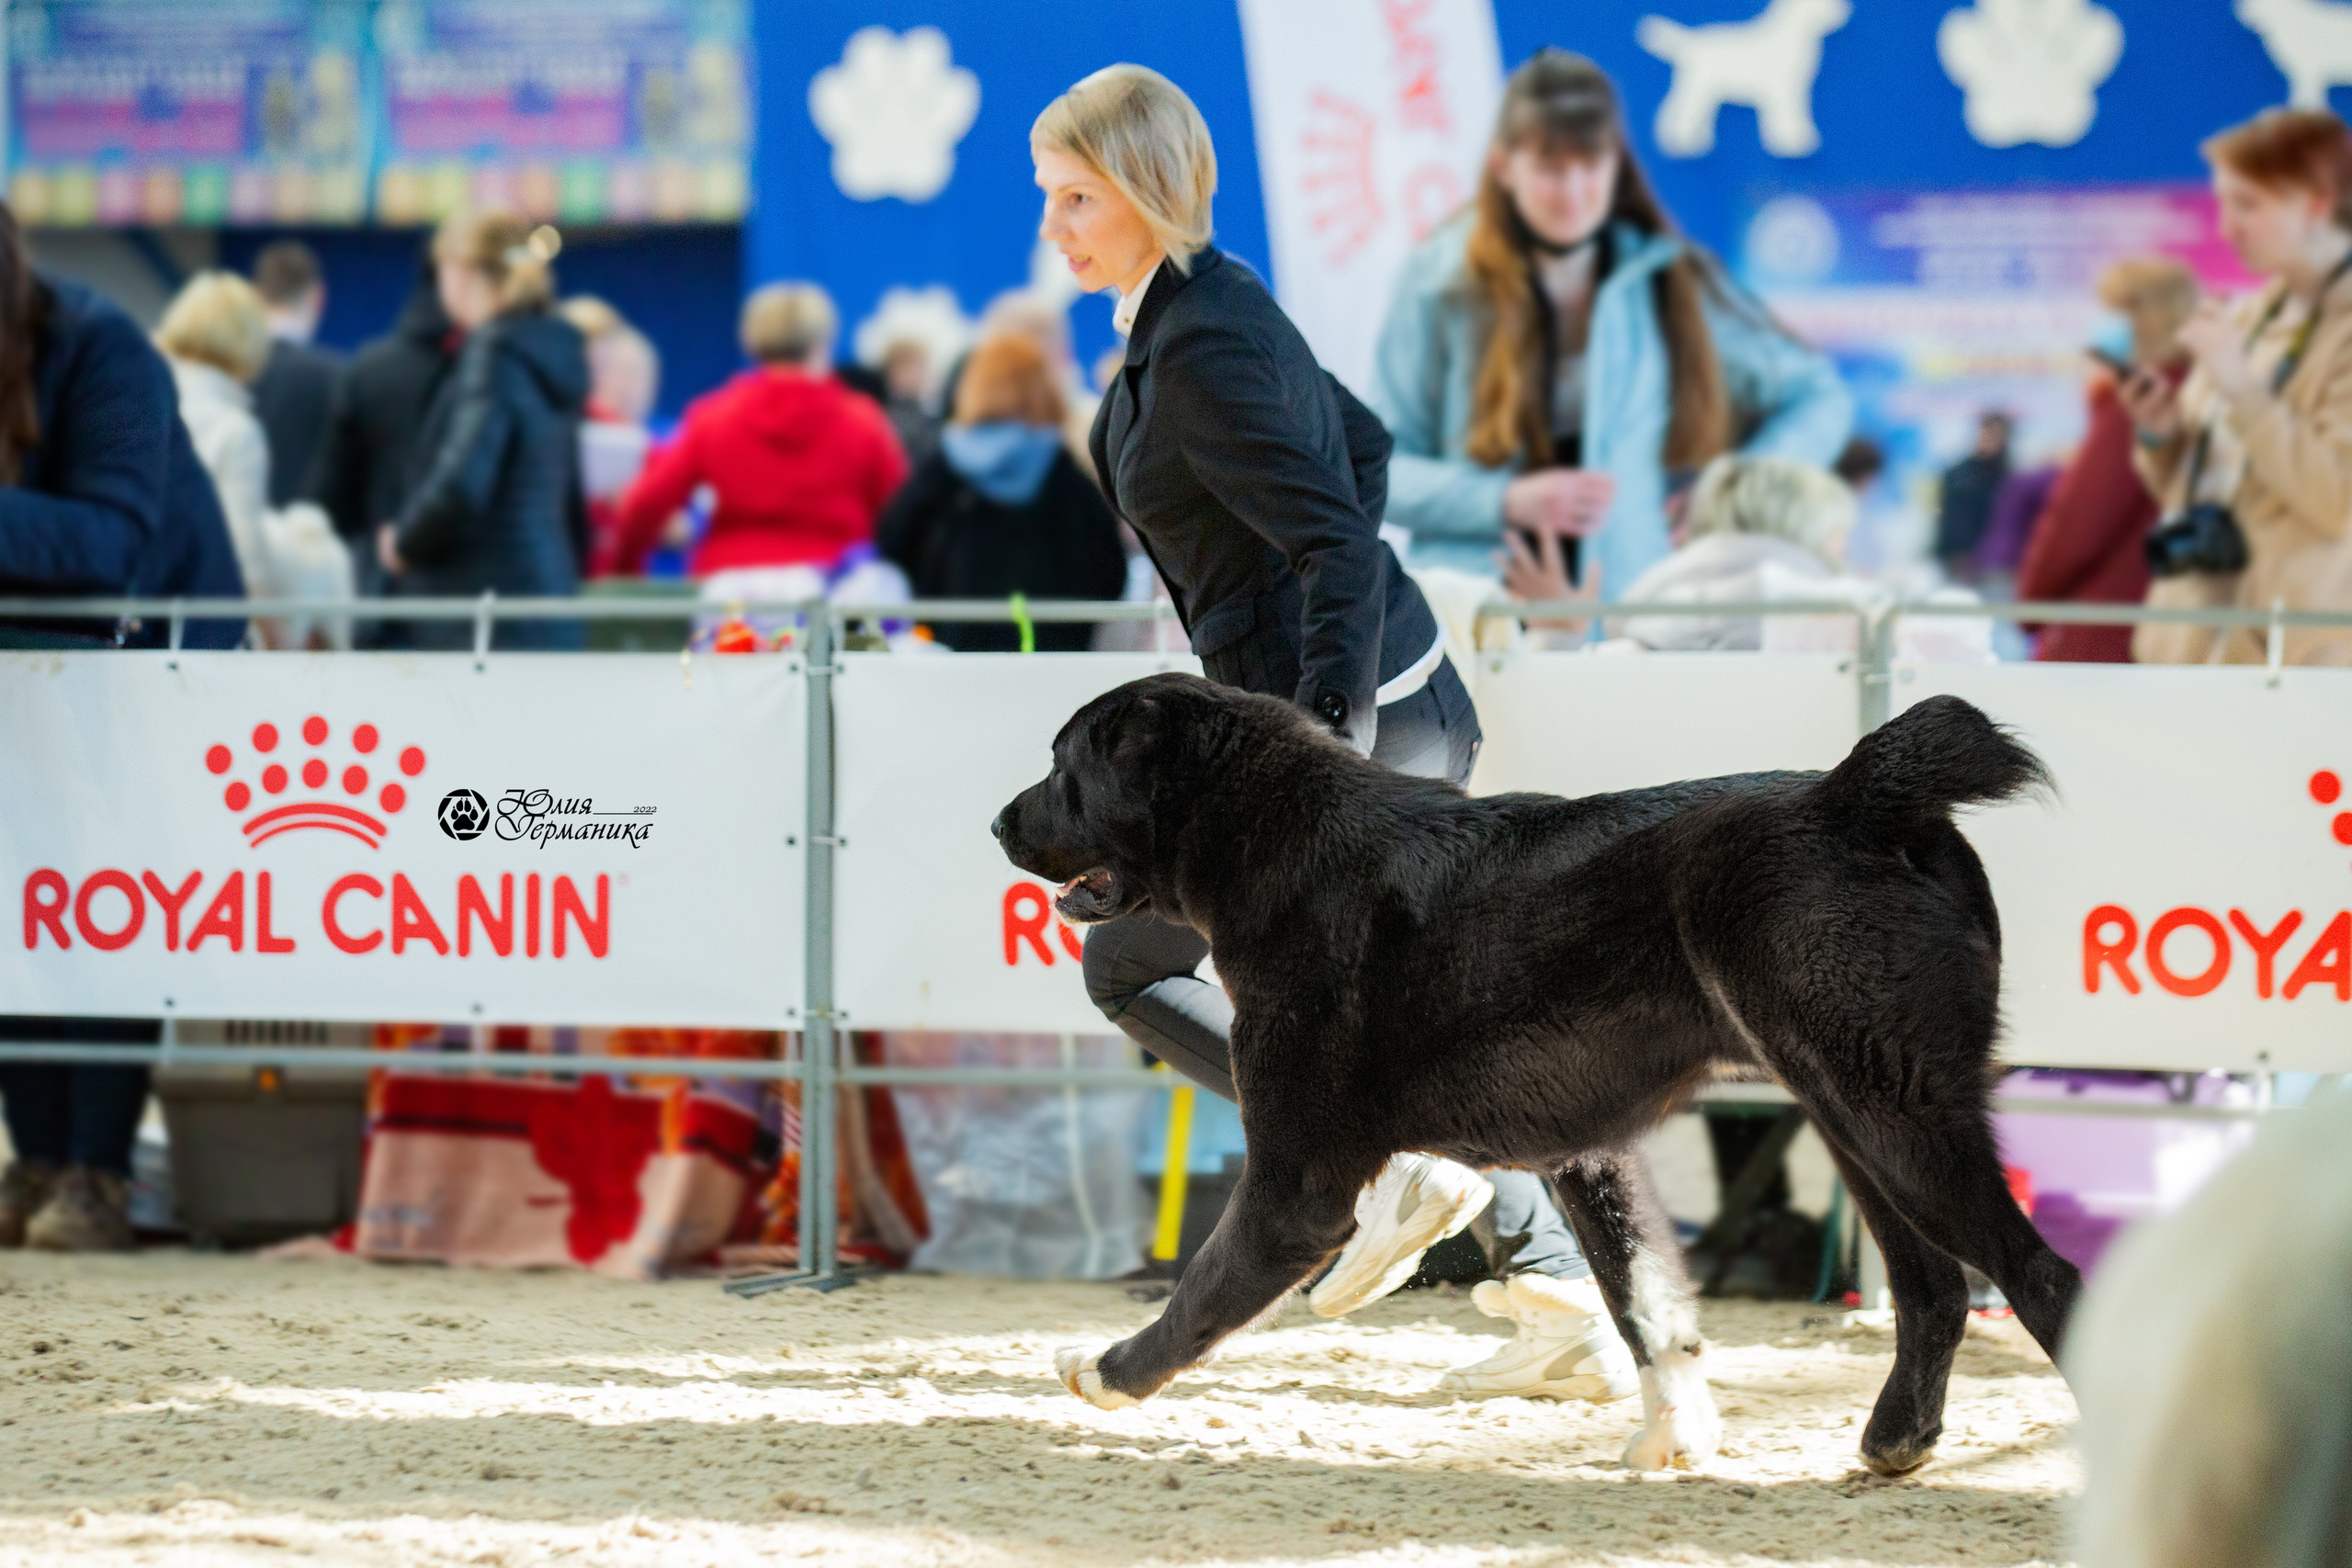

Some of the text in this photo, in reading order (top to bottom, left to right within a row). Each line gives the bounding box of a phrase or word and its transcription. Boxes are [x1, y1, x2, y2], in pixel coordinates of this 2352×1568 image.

[23, 868, 610, 959] ROYAL CANIN
[1002, 881, 1083, 966] R
[2082, 904, 2352, 1002] ROYA
